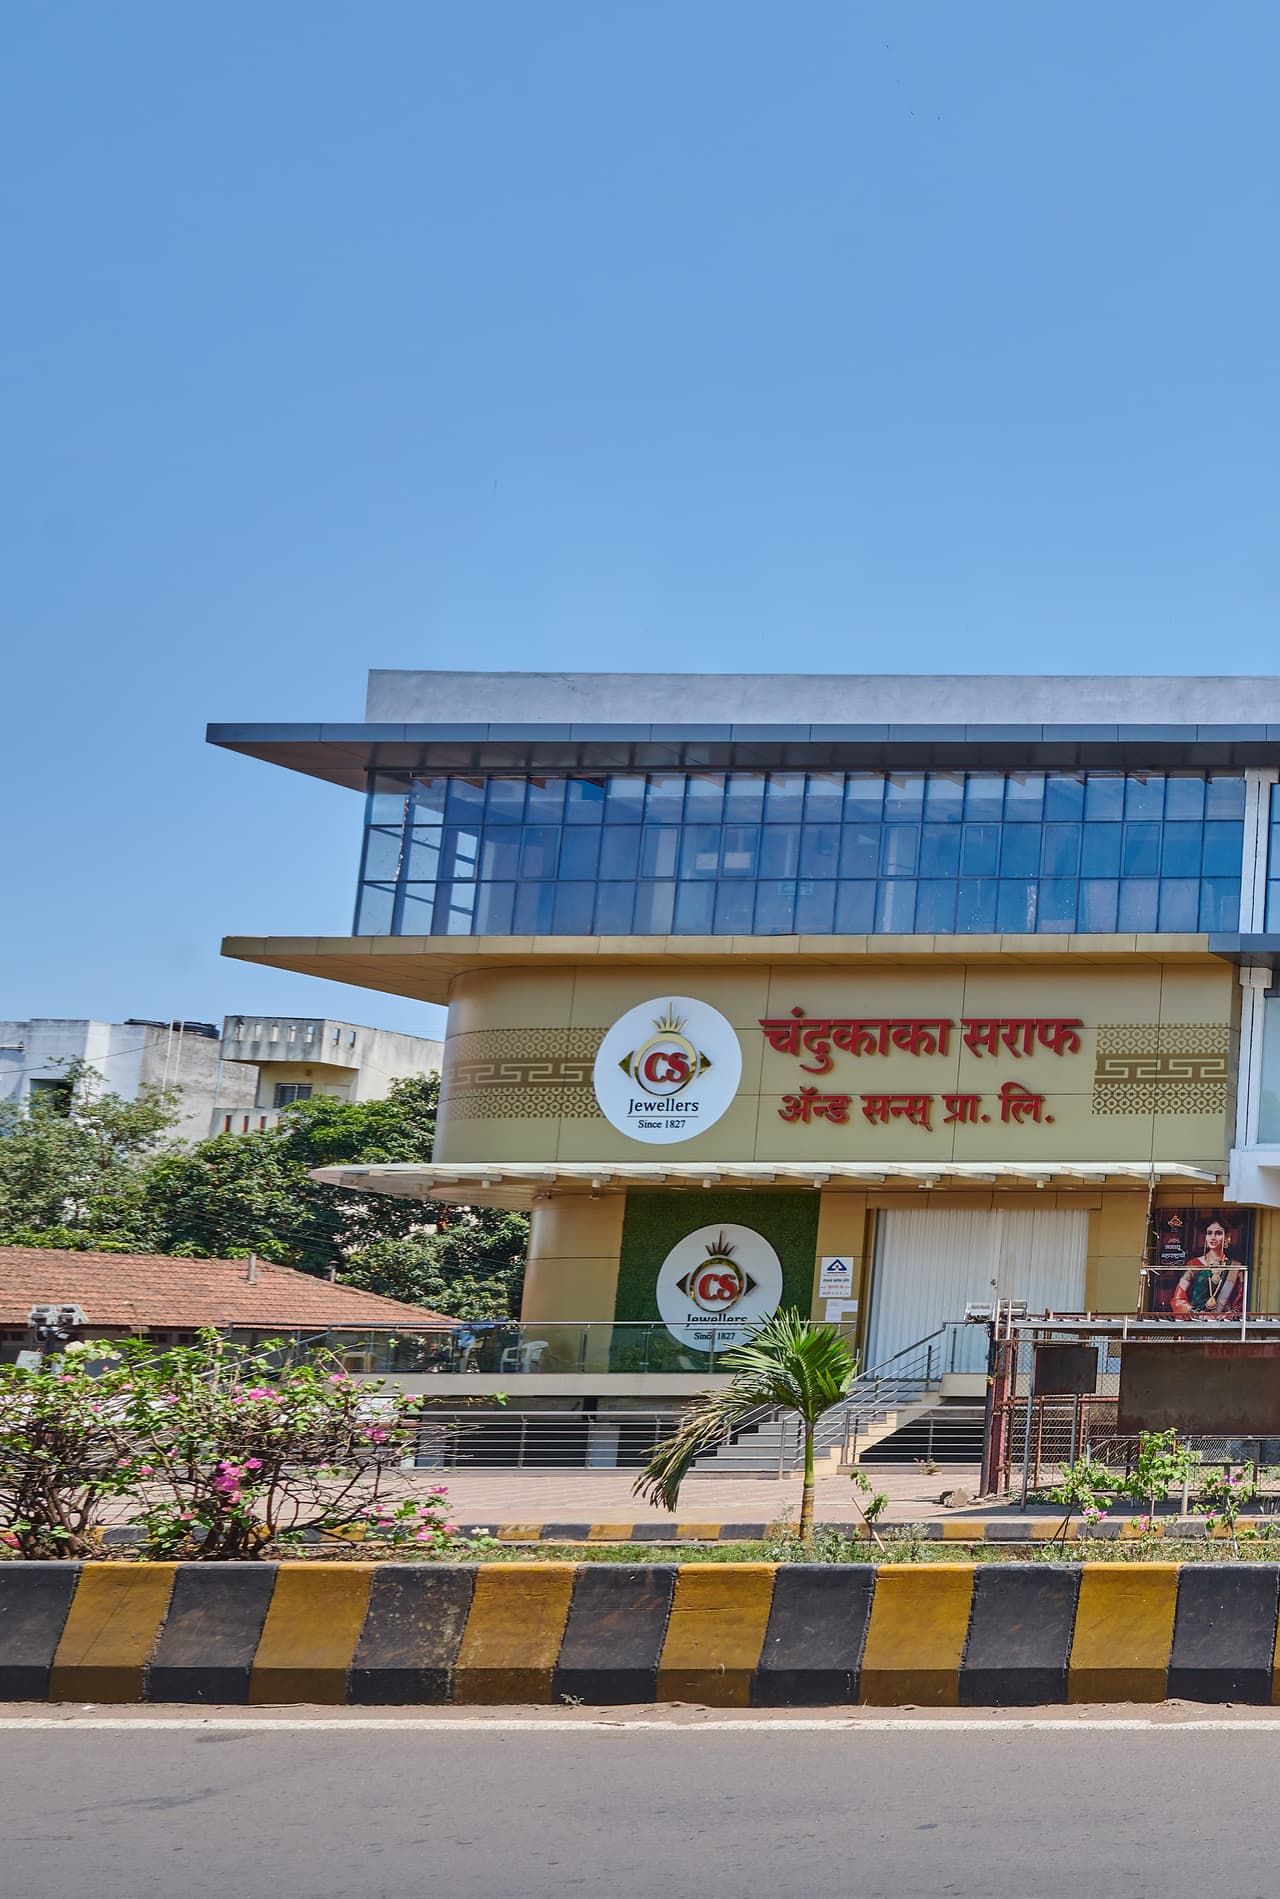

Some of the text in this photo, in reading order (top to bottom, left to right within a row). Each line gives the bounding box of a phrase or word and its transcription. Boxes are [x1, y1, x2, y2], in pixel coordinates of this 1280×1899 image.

[758, 1006, 1084, 1075] चंदुकाका सराफ
[644, 1052, 690, 1083] CS
[627, 1098, 700, 1115] Jewellers
[942, 1094, 991, 1124] प्रा.
[998, 1081, 1055, 1124] लि.
[638, 1119, 686, 1129] Since 1827
[698, 1273, 738, 1301] CS
[686, 1313, 748, 1328] Jewellers
